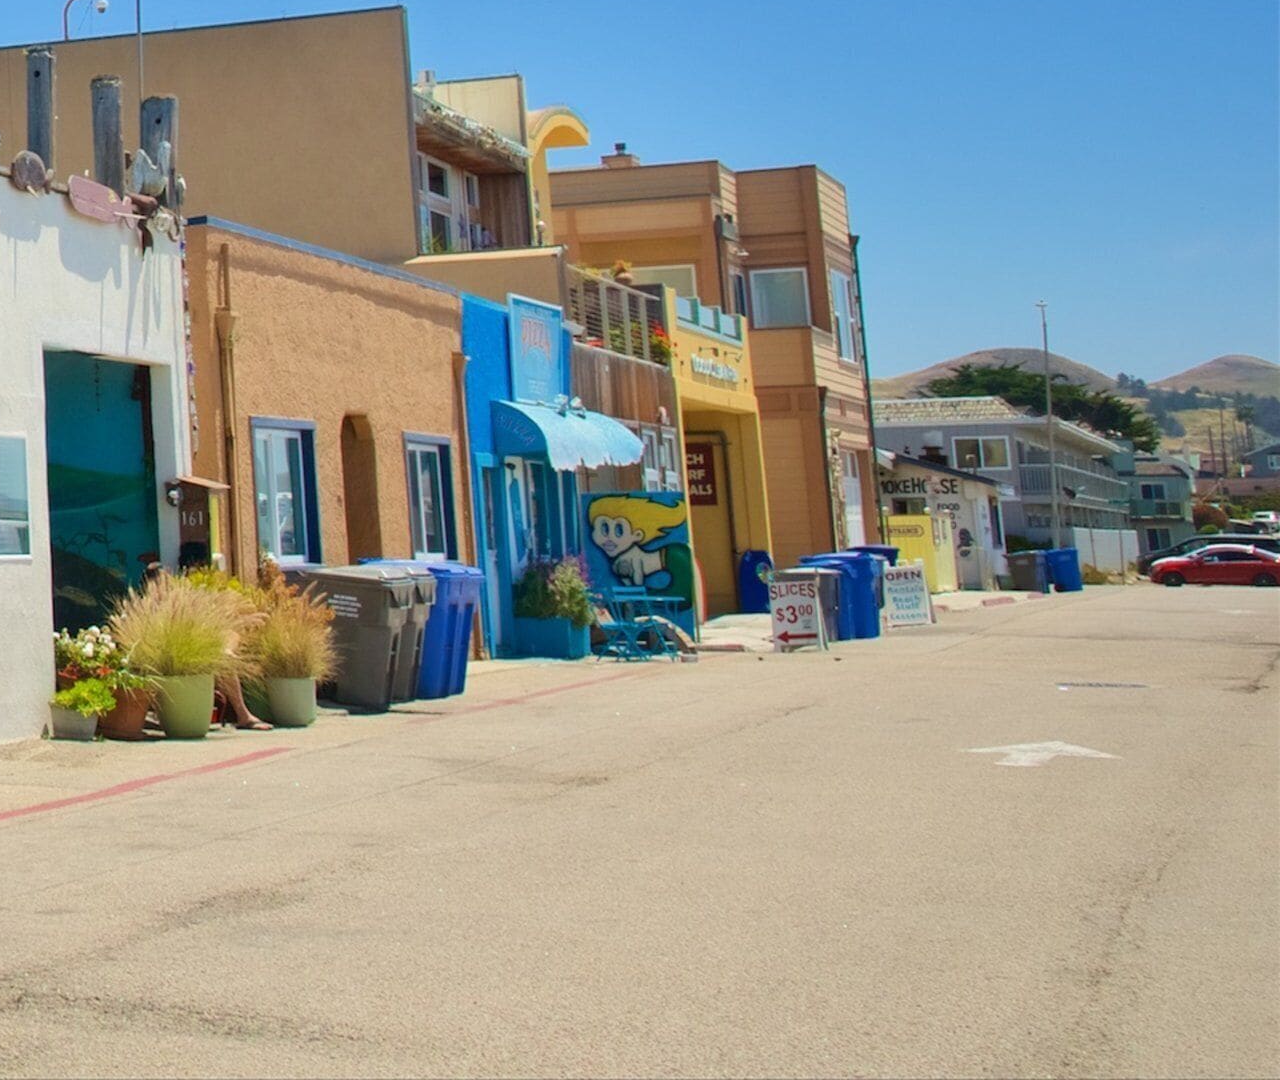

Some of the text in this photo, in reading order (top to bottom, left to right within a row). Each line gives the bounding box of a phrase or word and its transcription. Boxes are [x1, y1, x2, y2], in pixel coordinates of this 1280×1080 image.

[182, 511, 204, 526] 161
[885, 570, 922, 581] OPEN
[770, 583, 816, 601] SLICES
